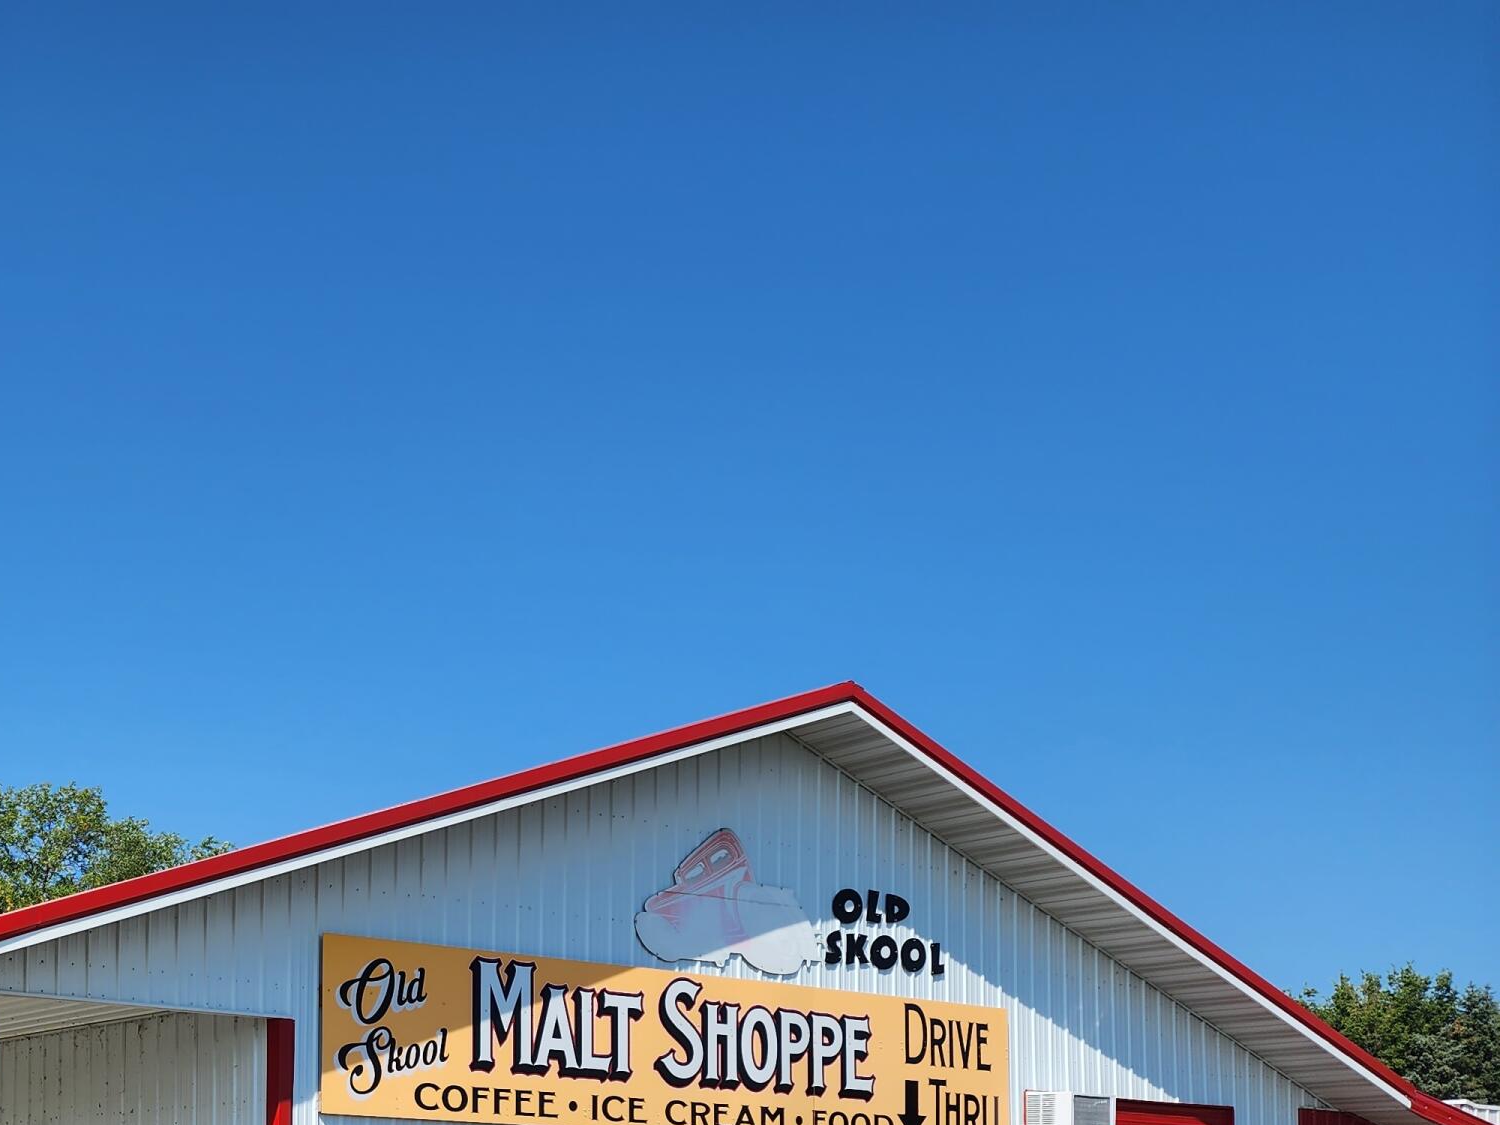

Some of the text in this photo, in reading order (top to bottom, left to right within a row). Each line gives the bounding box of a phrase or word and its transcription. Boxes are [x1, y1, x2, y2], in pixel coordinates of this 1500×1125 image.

[832, 888, 911, 924] OLD
[824, 930, 946, 976] SKOOL
[336, 957, 428, 1026] Old
[336, 1026, 450, 1099] Skool
[469, 955, 876, 1103] MALT SHOPPE
[903, 1002, 992, 1072] DRIVE
[414, 1082, 559, 1118] COFFEE
[590, 1094, 648, 1124] ICE
